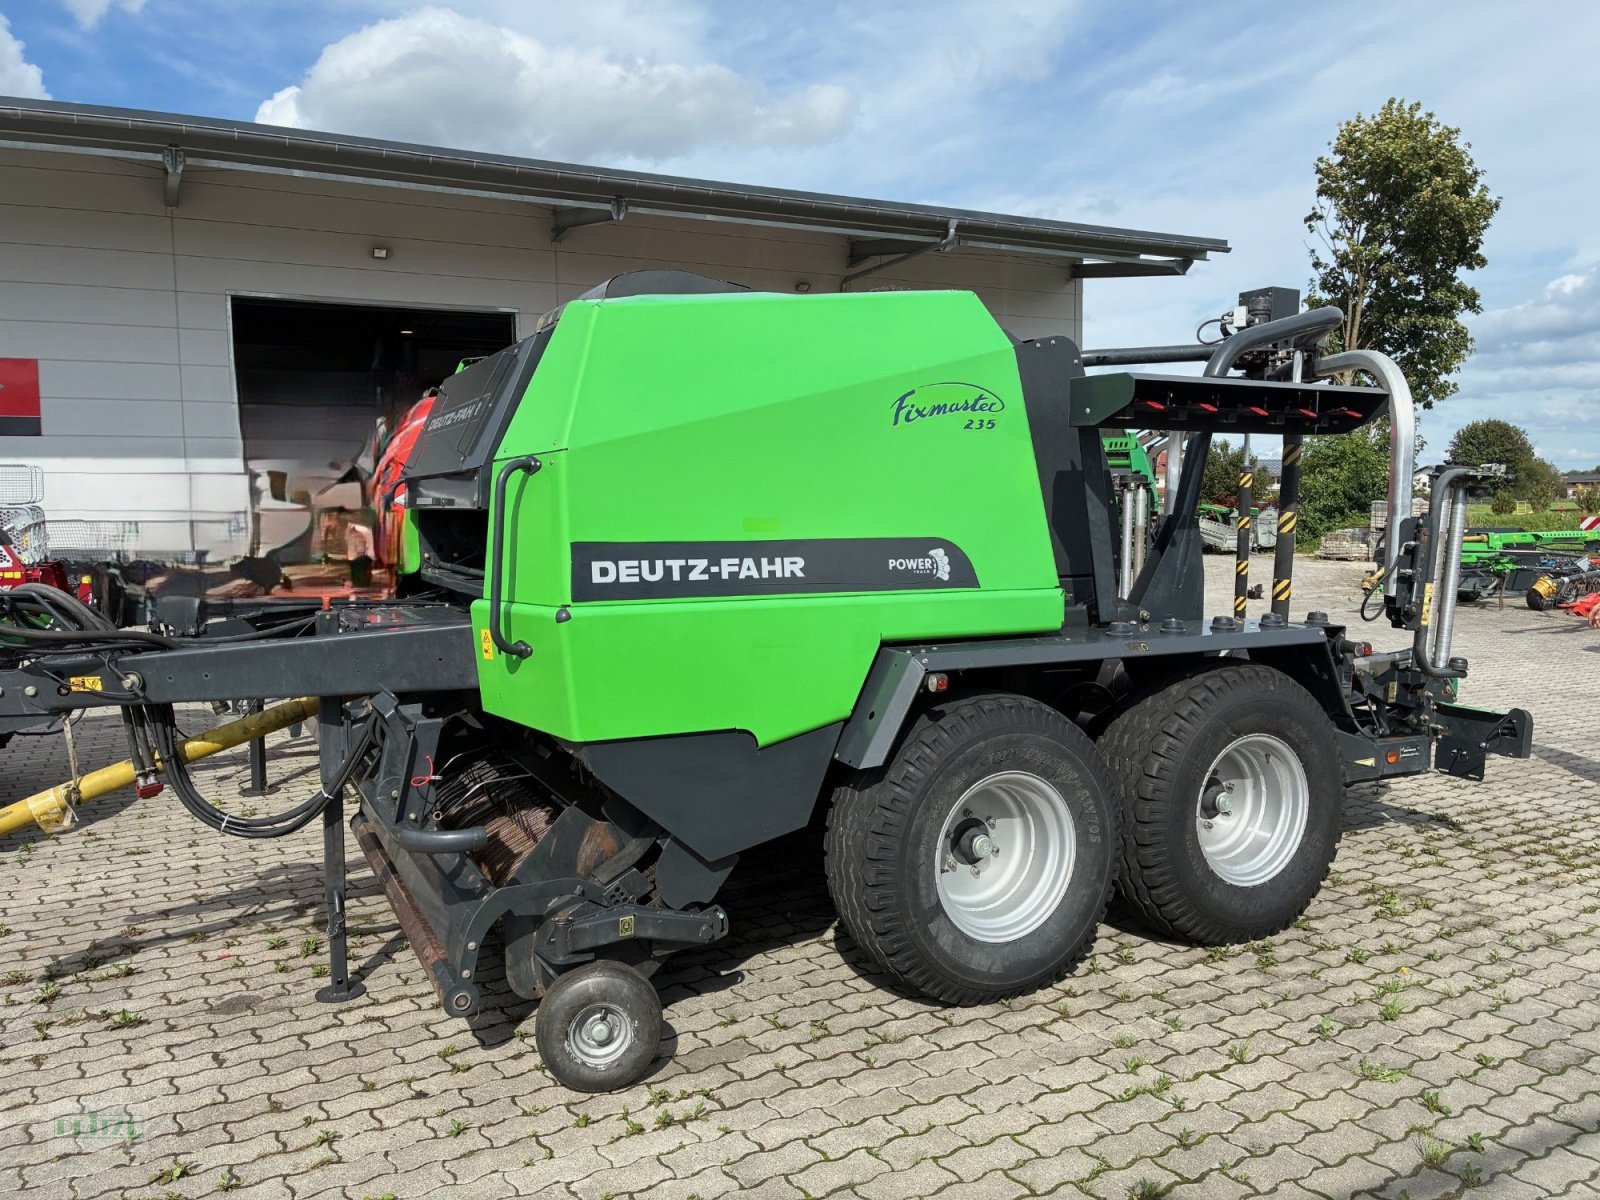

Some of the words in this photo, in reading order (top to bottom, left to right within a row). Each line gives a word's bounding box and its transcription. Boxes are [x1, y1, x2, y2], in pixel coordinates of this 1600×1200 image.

[963, 418, 996, 430] 235
[590, 557, 806, 584] DEUTZ-FAHR
[888, 558, 932, 571] POWER
